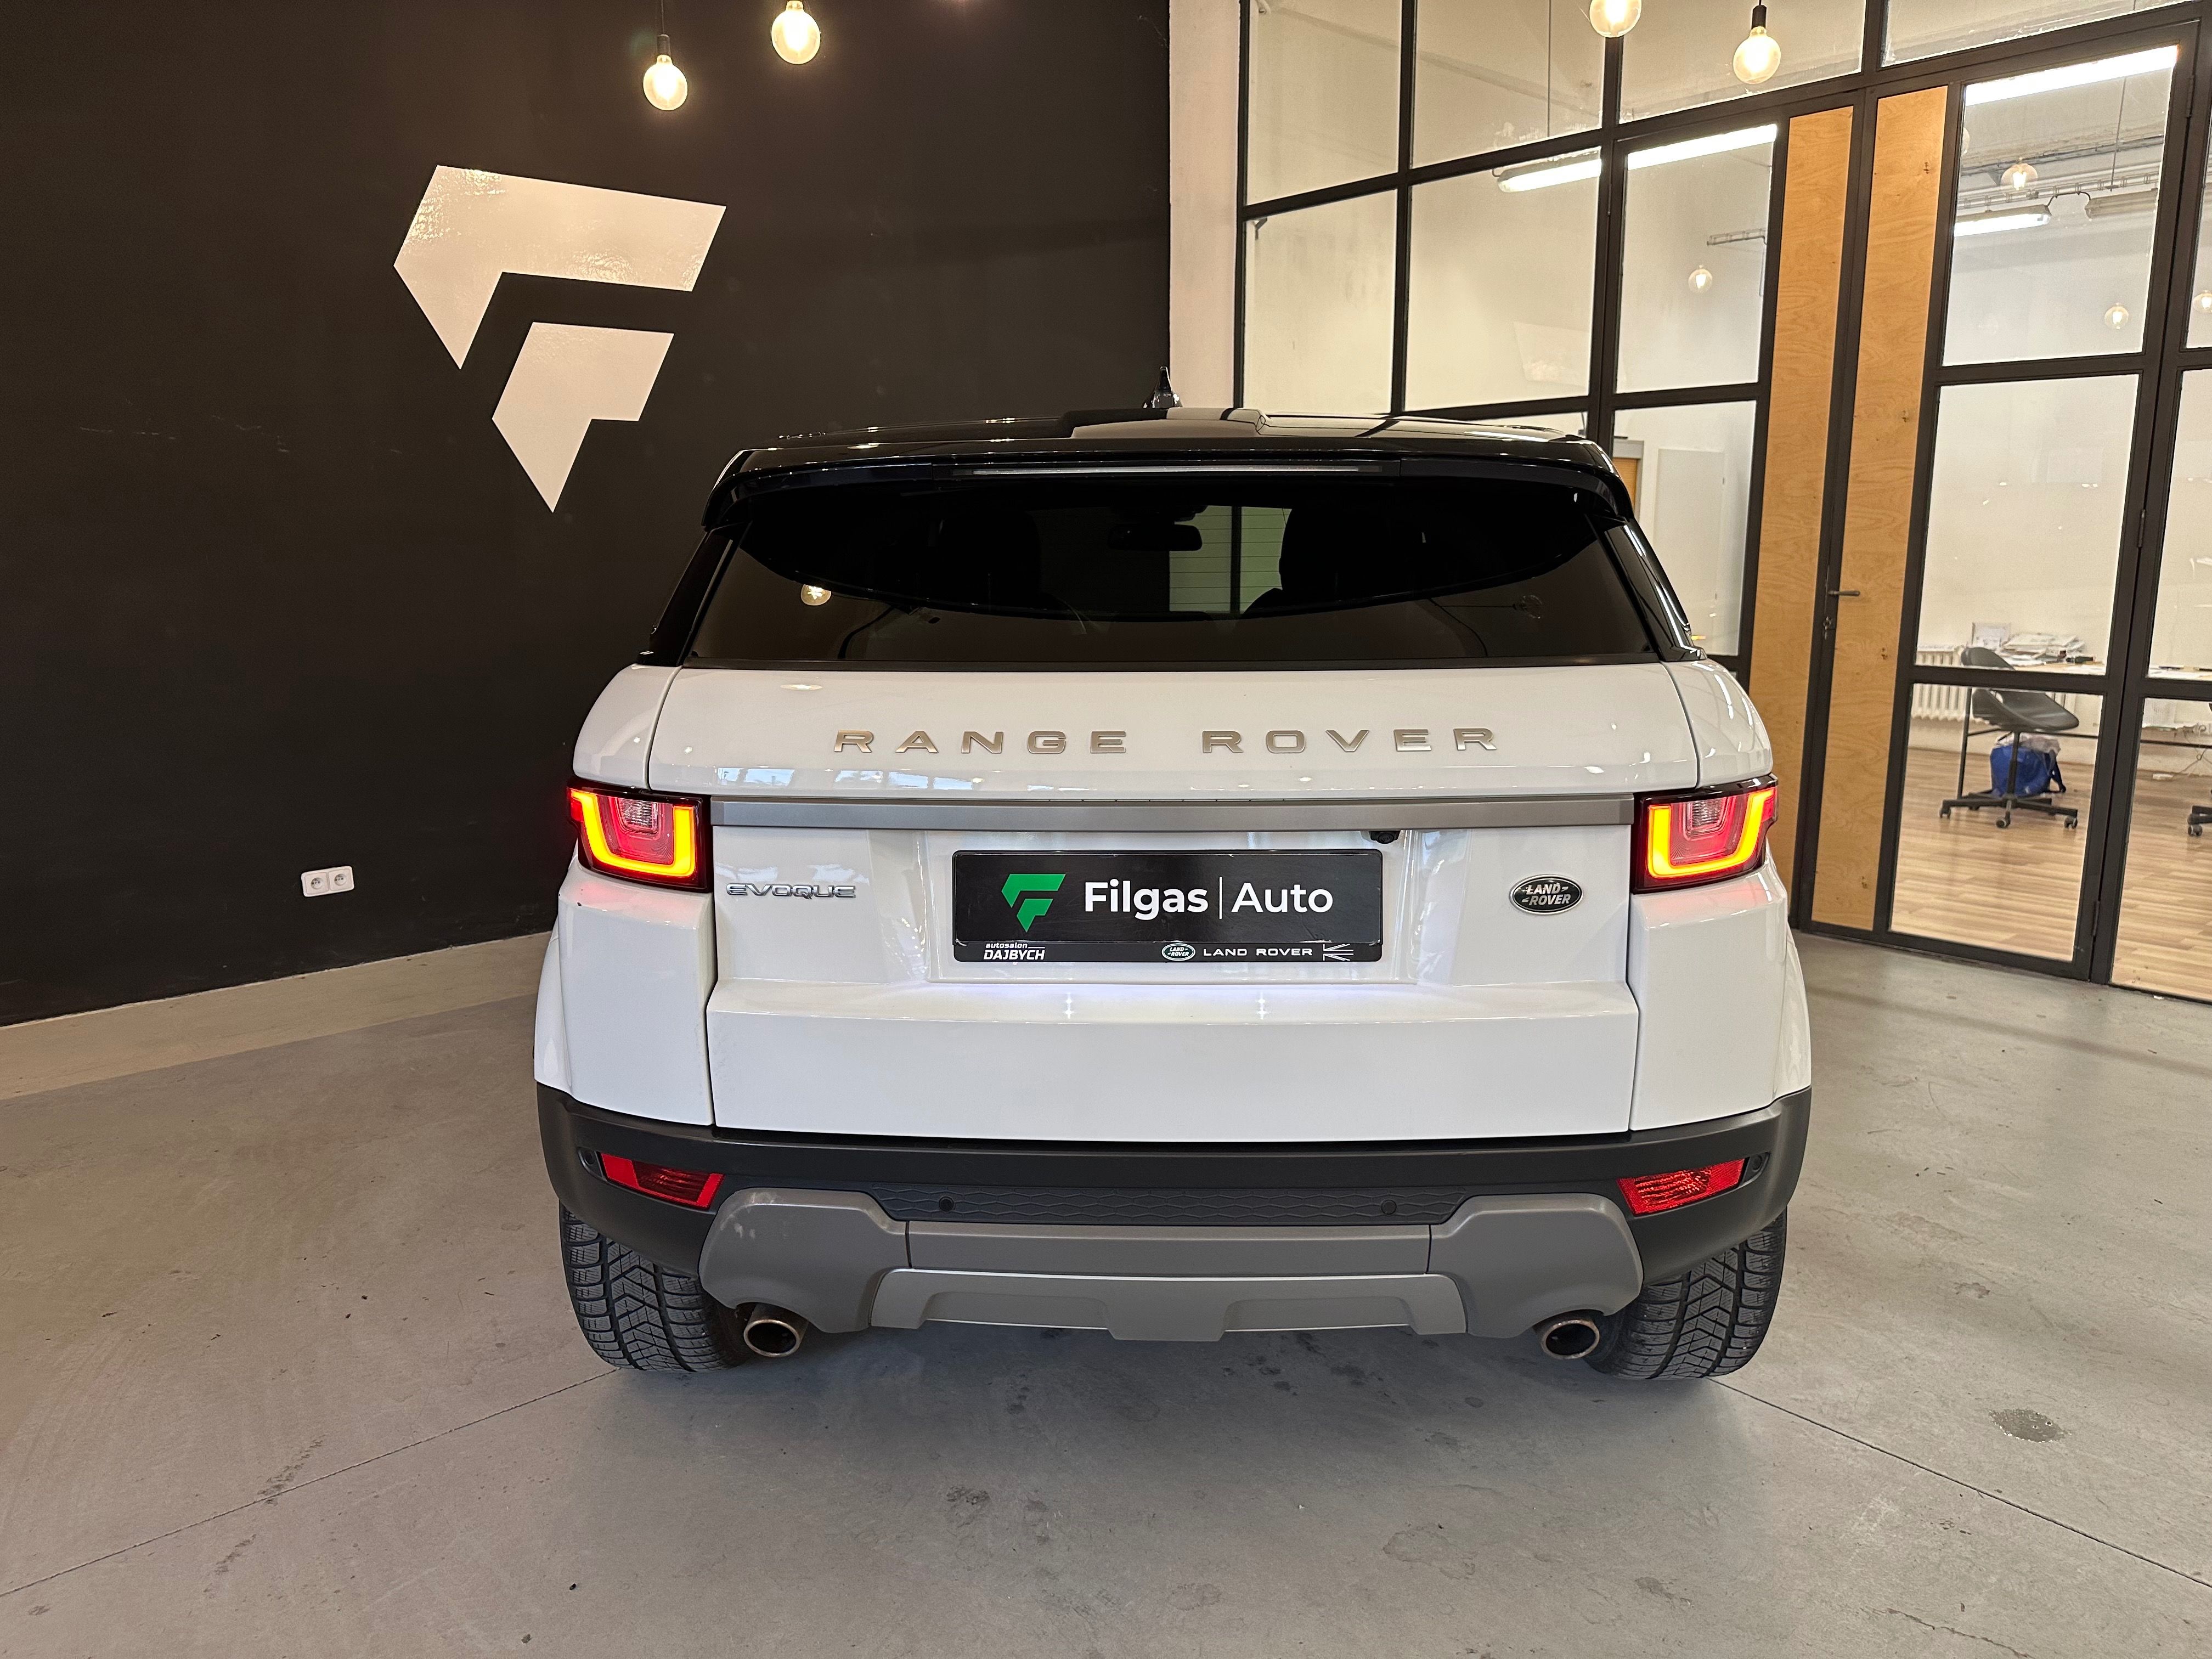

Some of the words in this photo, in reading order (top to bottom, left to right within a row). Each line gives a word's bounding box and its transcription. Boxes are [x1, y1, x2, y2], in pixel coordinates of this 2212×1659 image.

[833, 730, 1126, 754] RANGE
[1202, 727, 1498, 754] ROVER
[726, 883, 856, 900] EVOQUE
[1526, 883, 1561, 895] LAND
[1085, 878, 1209, 921] Filgas
[1231, 882, 1334, 913] Auto
[1528, 894, 1571, 906] ROVER
[983, 949, 1045, 960] DAJBYCH
[1203, 948, 1248, 956] LAND
[1256, 947, 1313, 956] ROVER
